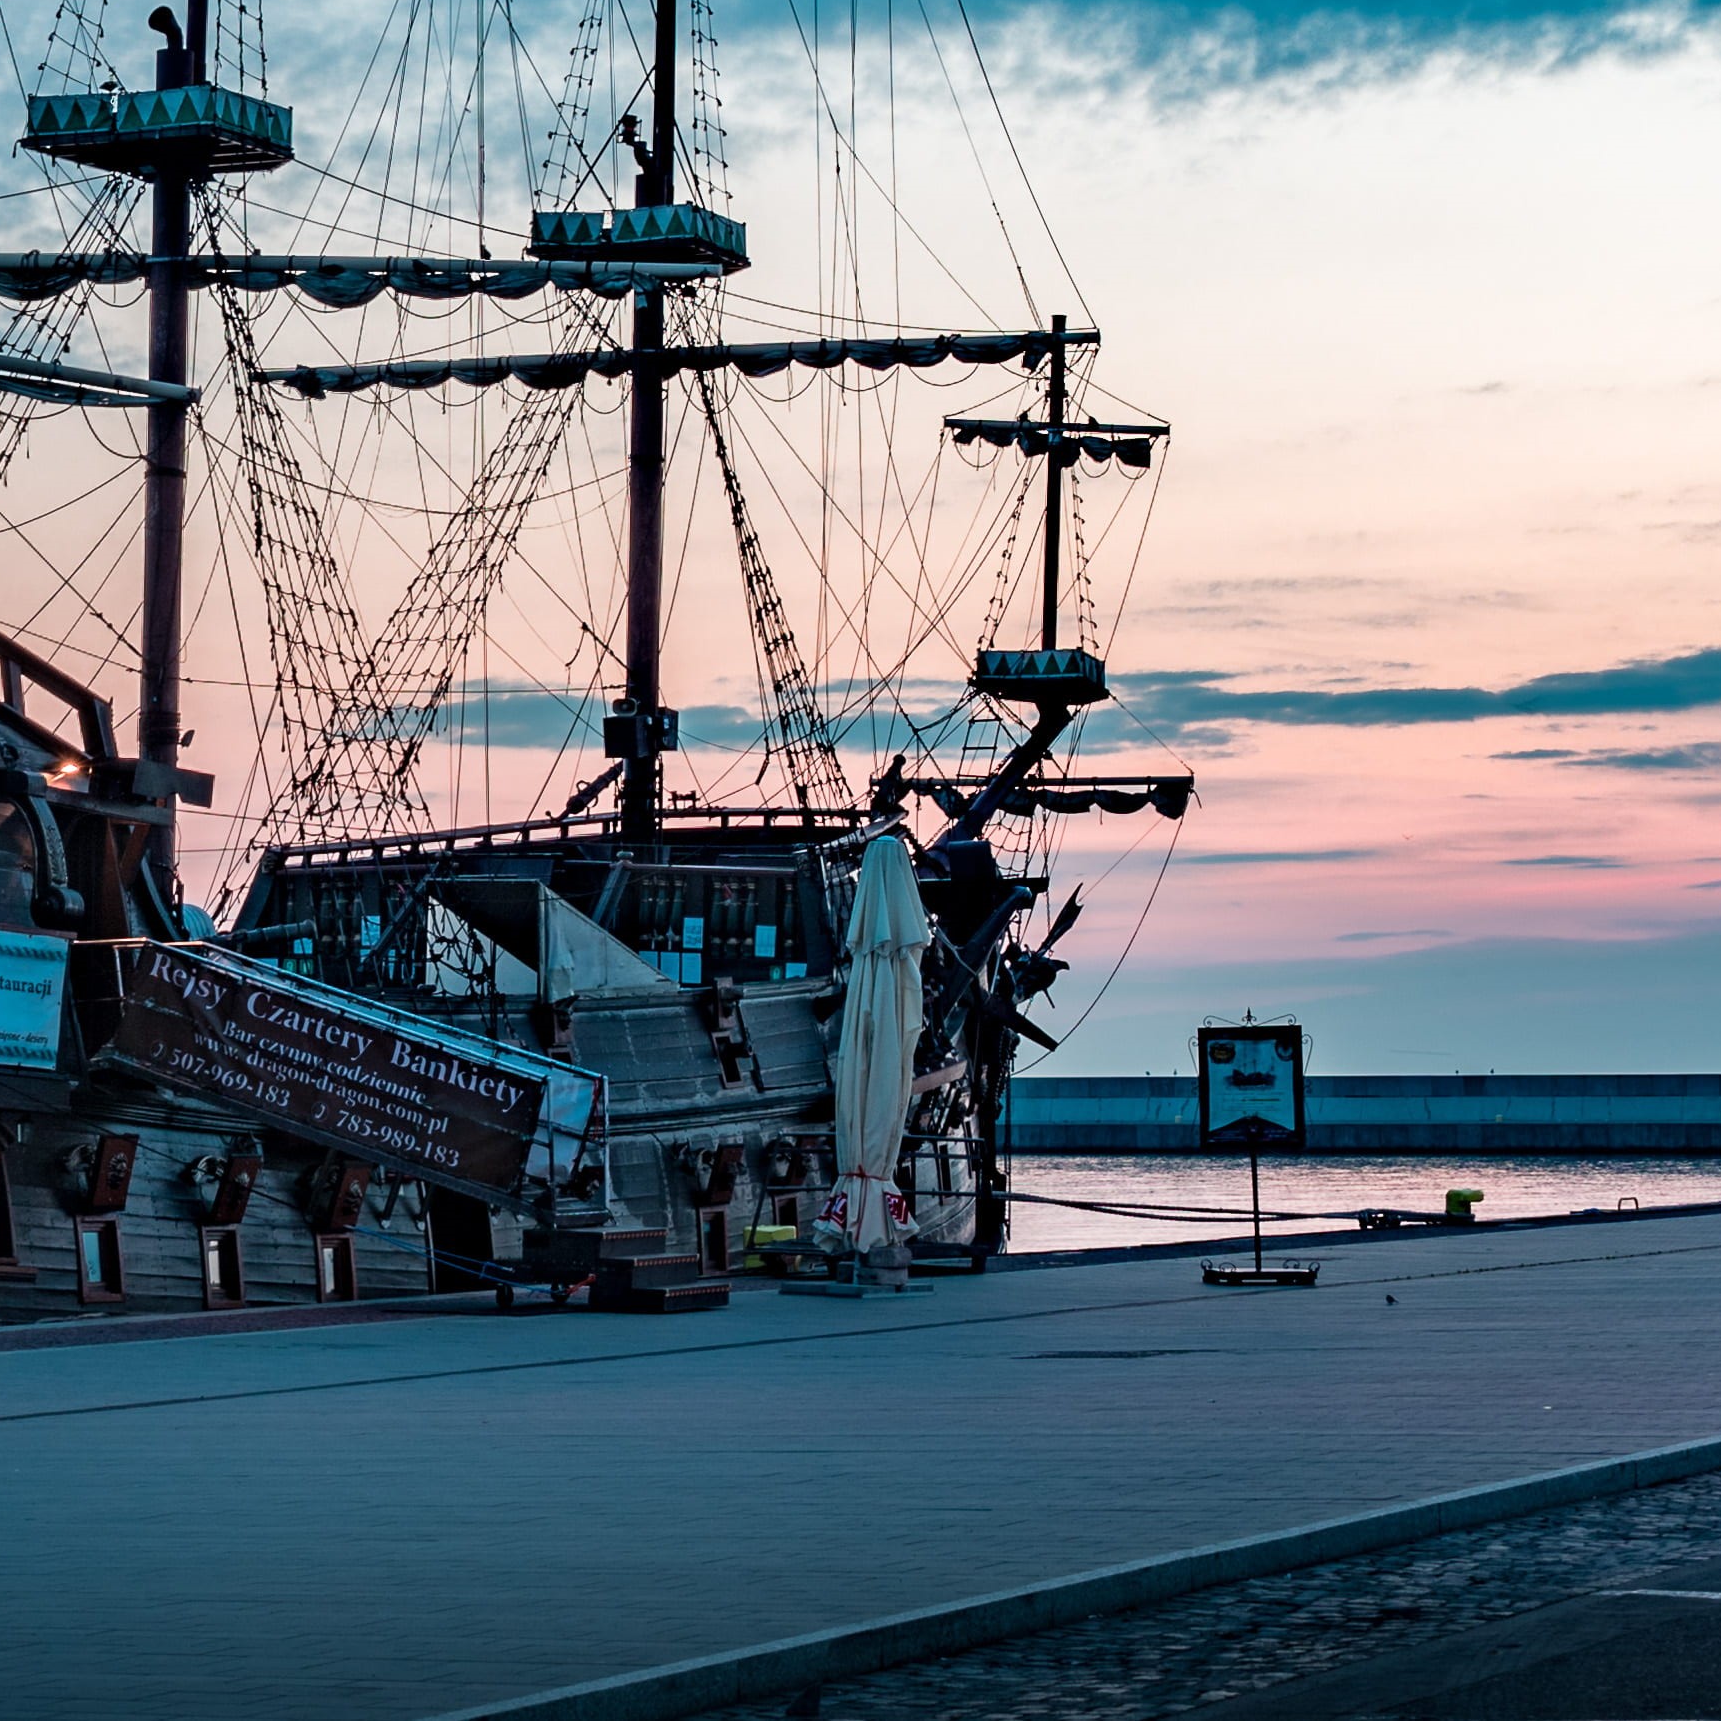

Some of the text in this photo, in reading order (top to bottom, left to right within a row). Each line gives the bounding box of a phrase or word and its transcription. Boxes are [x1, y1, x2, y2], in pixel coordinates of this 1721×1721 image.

[149, 952, 524, 1113] Rejsy Czartery Bankiety
[194, 1033, 449, 1135] www. dragon-dragon.com.pl
[222, 1021, 427, 1105] Bar czynny codziennie
[169, 1048, 460, 1167] 507-969-183 785-989-183
